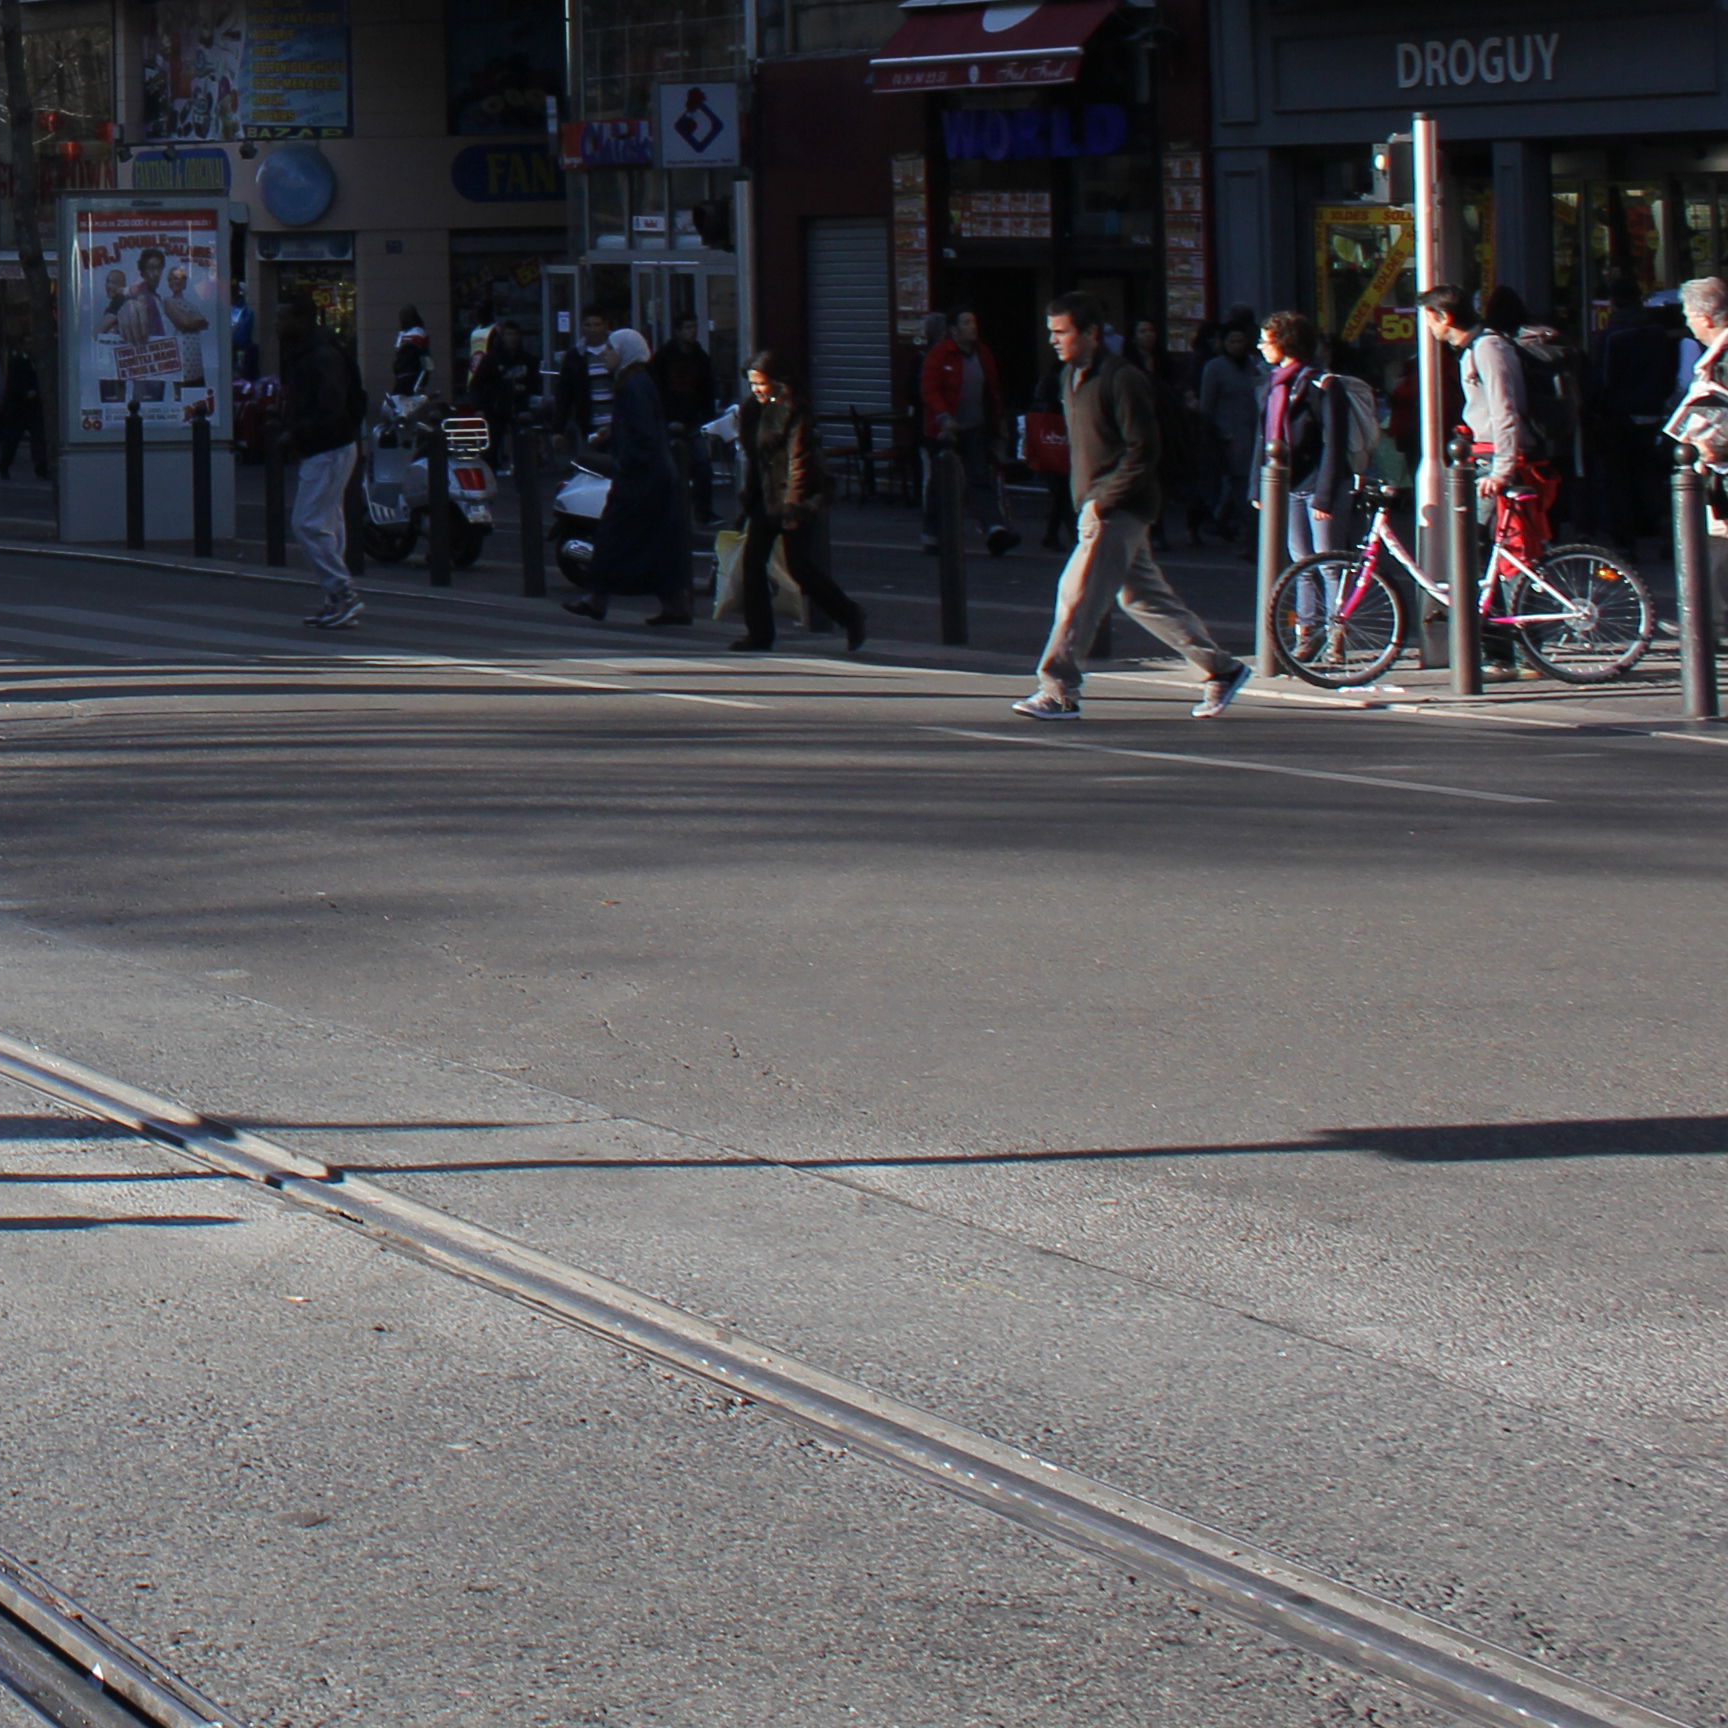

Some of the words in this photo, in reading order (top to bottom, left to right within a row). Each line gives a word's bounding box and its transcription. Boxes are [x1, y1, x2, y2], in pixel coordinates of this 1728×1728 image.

[1396, 32, 1560, 89] DROGUY
[942, 103, 1129, 161] WORLD
[1373, 249, 1405, 292] SOLDES
[1380, 313, 1414, 340] 50
